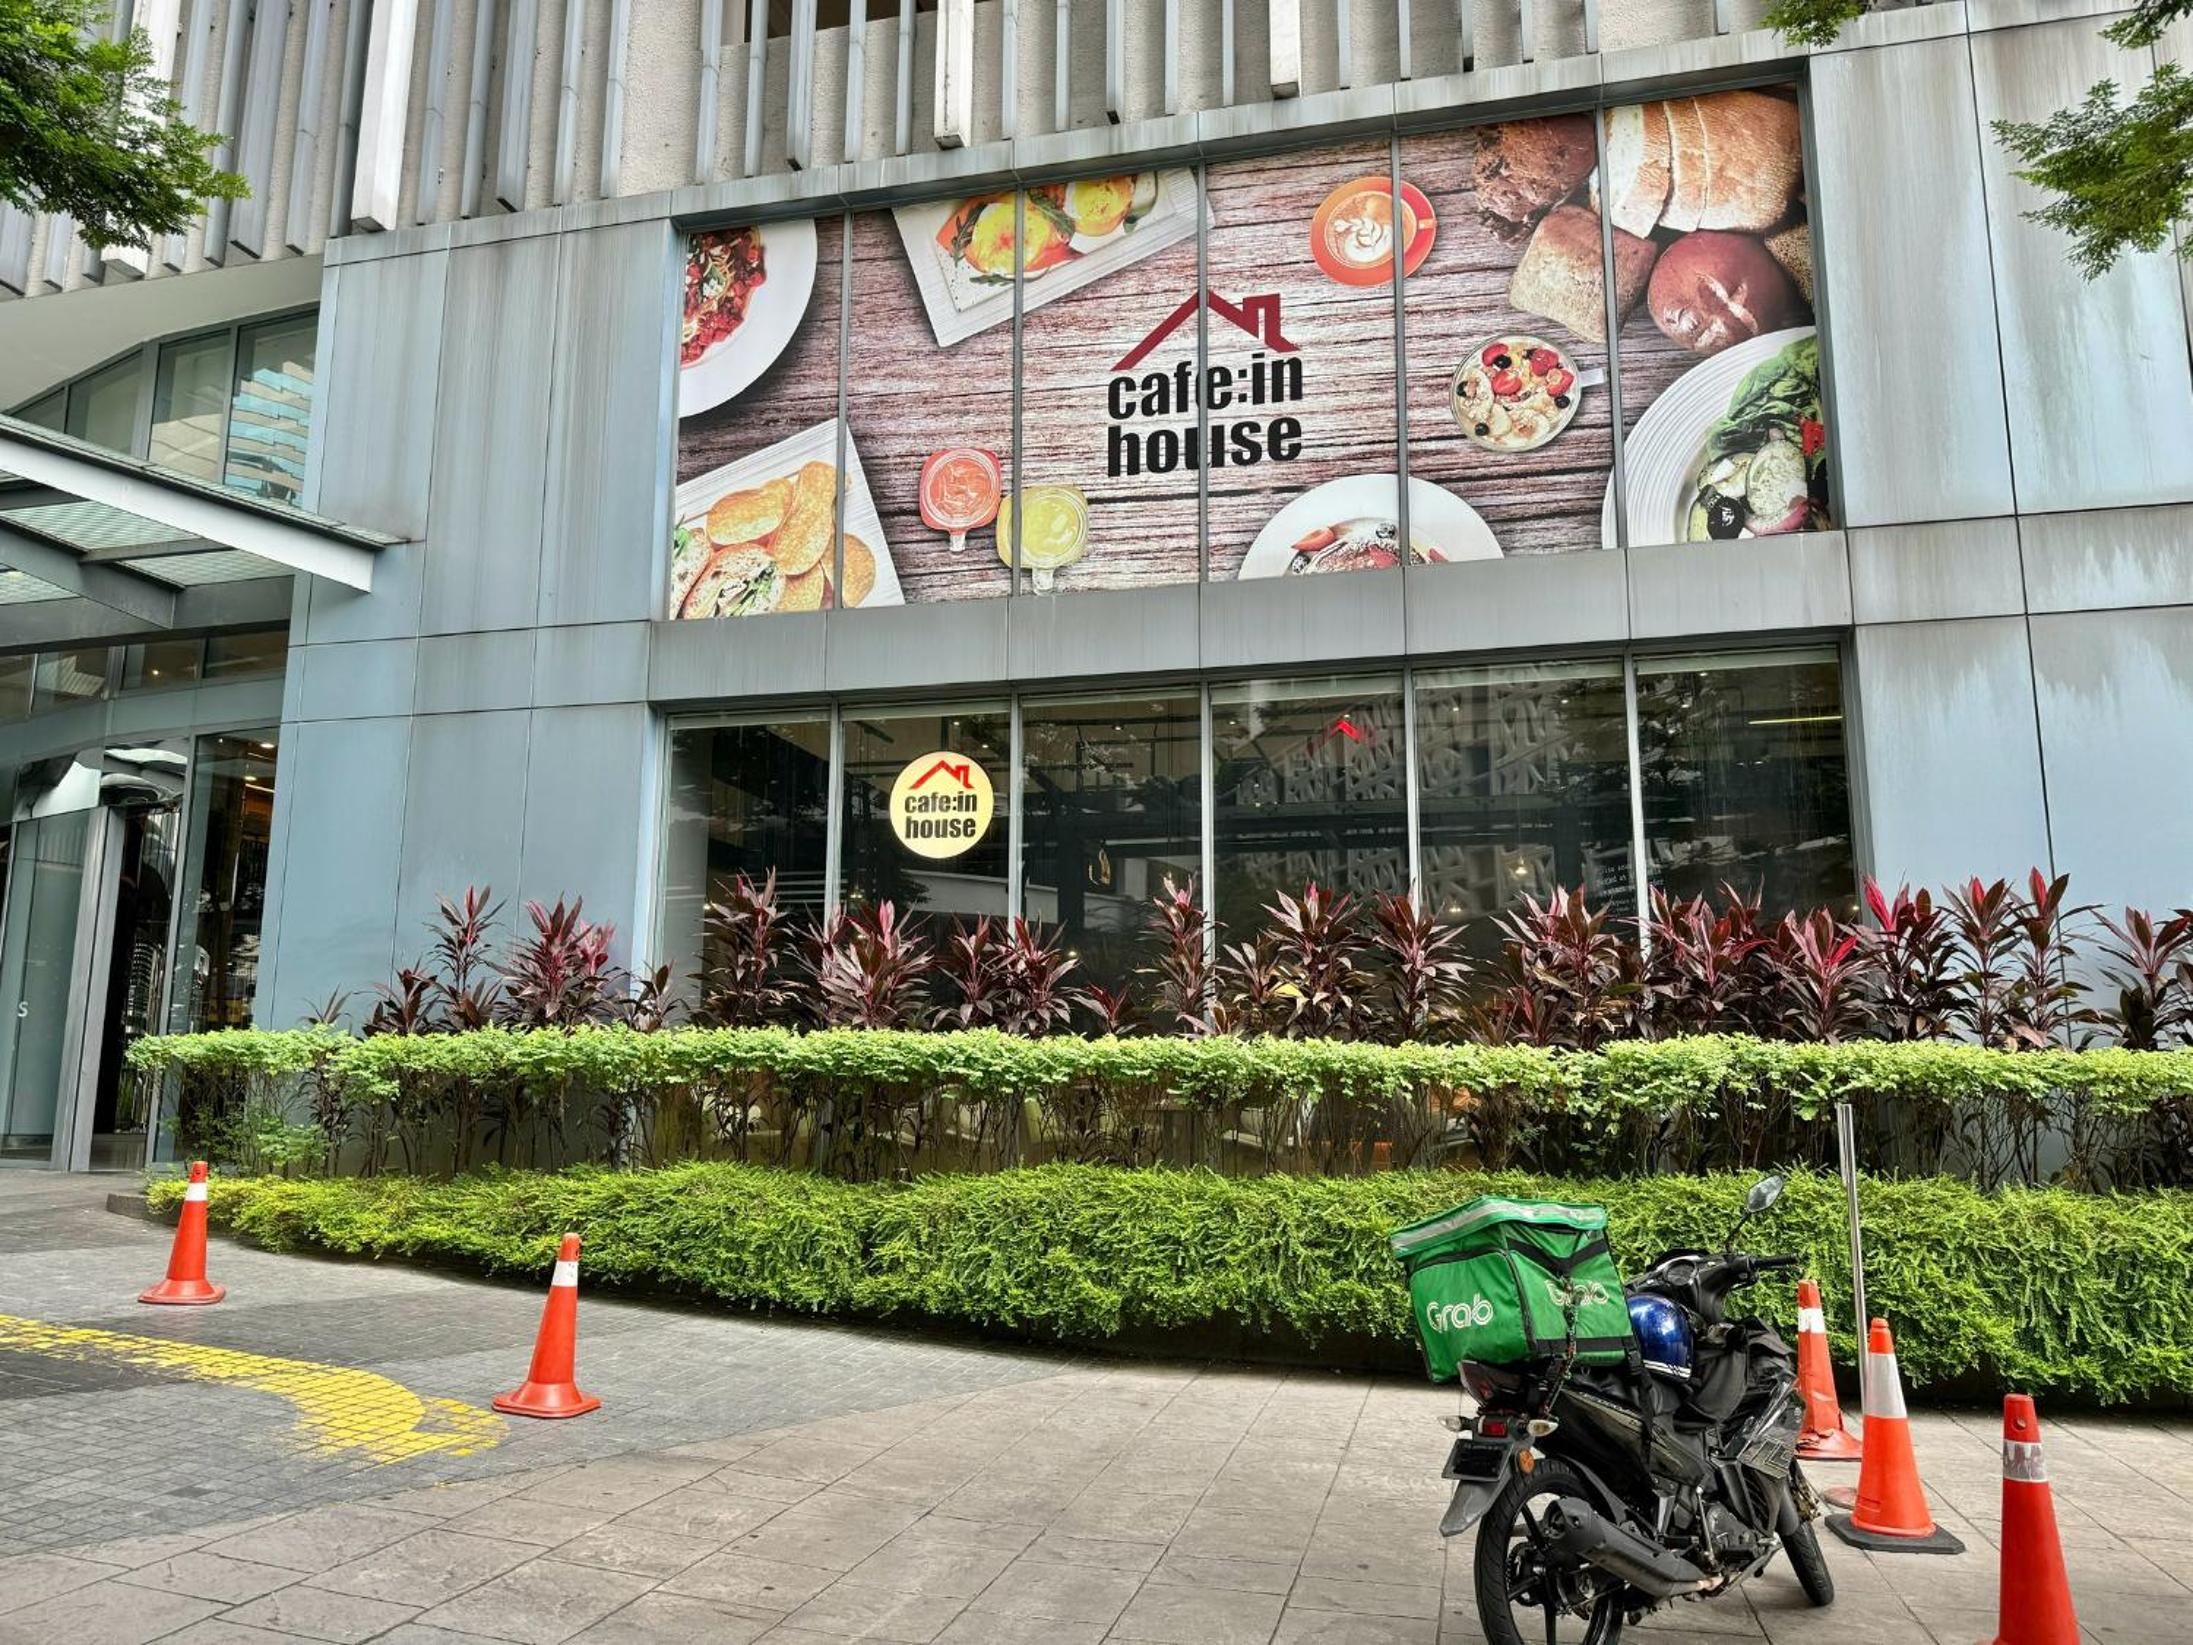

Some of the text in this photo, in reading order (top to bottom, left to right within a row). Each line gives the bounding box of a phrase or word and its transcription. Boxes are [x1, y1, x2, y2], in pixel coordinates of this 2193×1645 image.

[1108, 352, 1303, 420] cafe:in
[1108, 417, 1302, 477] house
[904, 791, 978, 813] cafe:in
[904, 816, 977, 839] house
[1426, 1293, 1494, 1333] Grab
